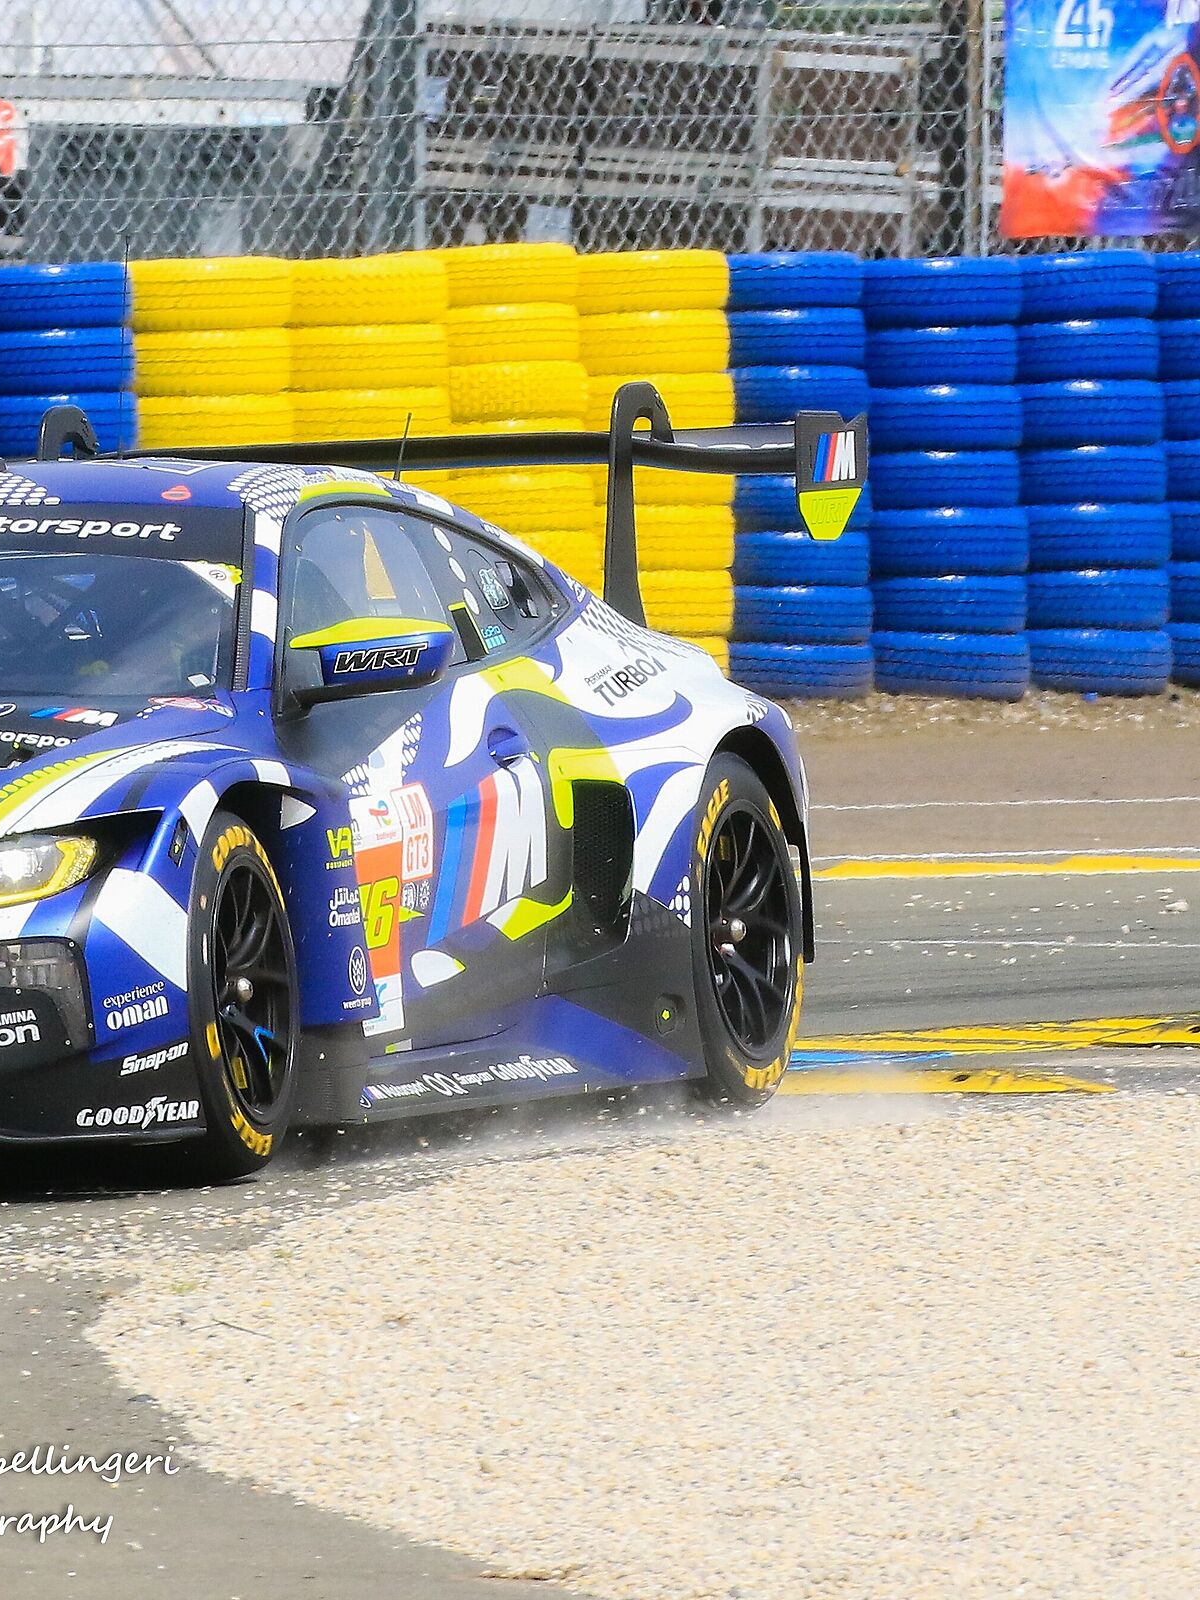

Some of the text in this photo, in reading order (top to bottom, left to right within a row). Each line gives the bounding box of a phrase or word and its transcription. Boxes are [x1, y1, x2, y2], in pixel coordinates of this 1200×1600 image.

[811, 496, 849, 525] WRT
[333, 642, 428, 674] WRT
[400, 792, 427, 830] LM
[406, 832, 429, 873] GT3
[103, 981, 165, 1008] experience
[106, 995, 169, 1031] oman
[119, 1041, 189, 1077] Snap-on
[488, 1054, 579, 1081] GOODYEAR
[76, 1096, 200, 1130] GOODYEAR
